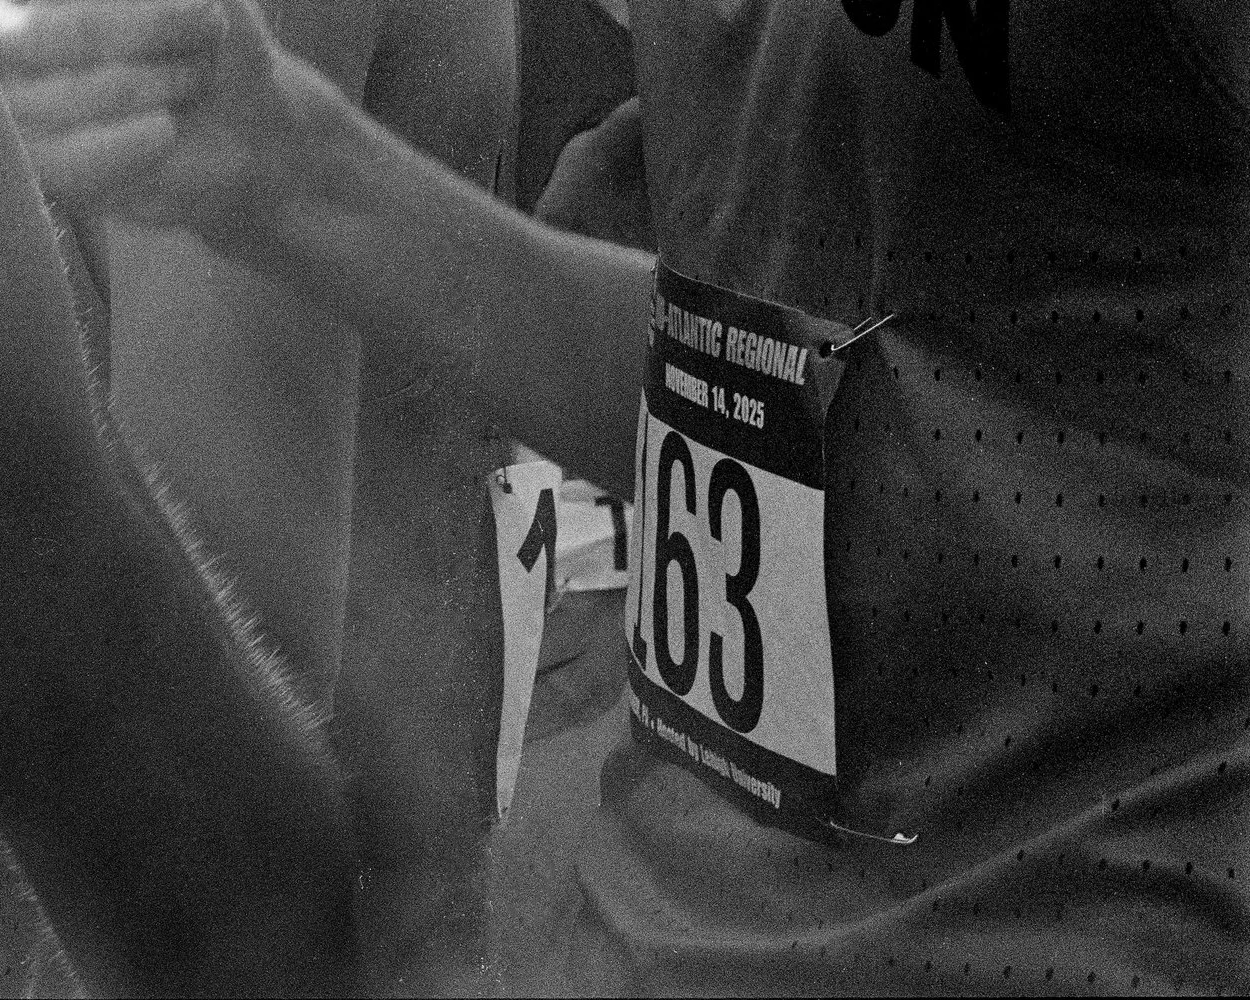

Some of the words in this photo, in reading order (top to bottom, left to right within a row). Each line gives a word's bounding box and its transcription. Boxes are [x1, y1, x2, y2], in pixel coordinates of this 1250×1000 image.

[726, 326, 808, 386] REGIONAL
[711, 386, 730, 419] 14,
[733, 392, 765, 430] 2025
[730, 761, 781, 810] University
